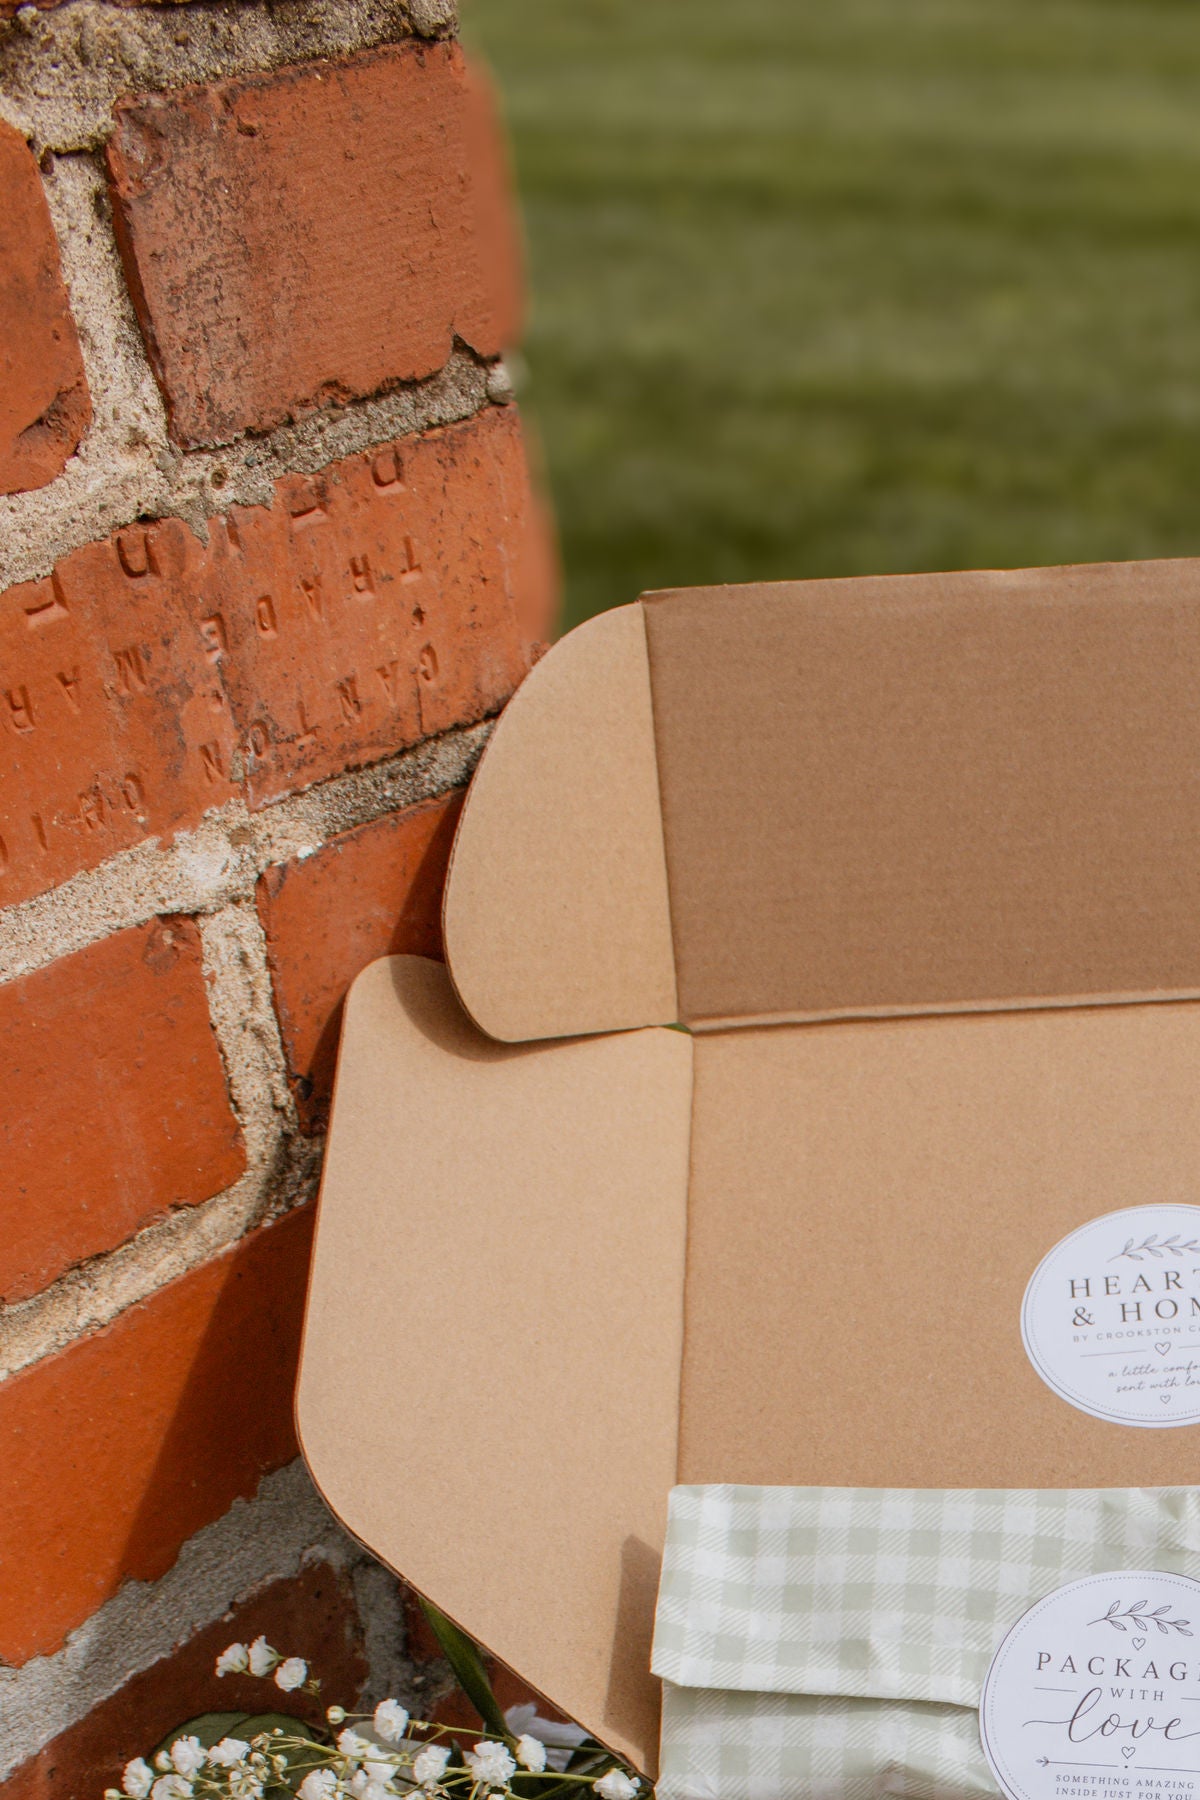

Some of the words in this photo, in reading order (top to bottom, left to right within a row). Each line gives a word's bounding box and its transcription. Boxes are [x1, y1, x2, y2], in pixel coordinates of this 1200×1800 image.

[4, 645, 147, 736] MAR
[1071, 1306, 1096, 1327] &
[1073, 1334, 1089, 1343] BY
[1096, 1326, 1182, 1341] CROOKSTON
[1121, 1362, 1159, 1378] little
[1116, 1381, 1146, 1394] sent
[1149, 1377, 1181, 1390] with
[1110, 1687, 1165, 1701] WITH
[1056, 1774, 1130, 1786] SOMETHING
[1136, 1779, 1195, 1790] AMAZING
[1056, 1787, 1098, 1797] INSIDE
[1103, 1790, 1133, 1799] JUST
[1138, 1792, 1162, 1800] FOR
